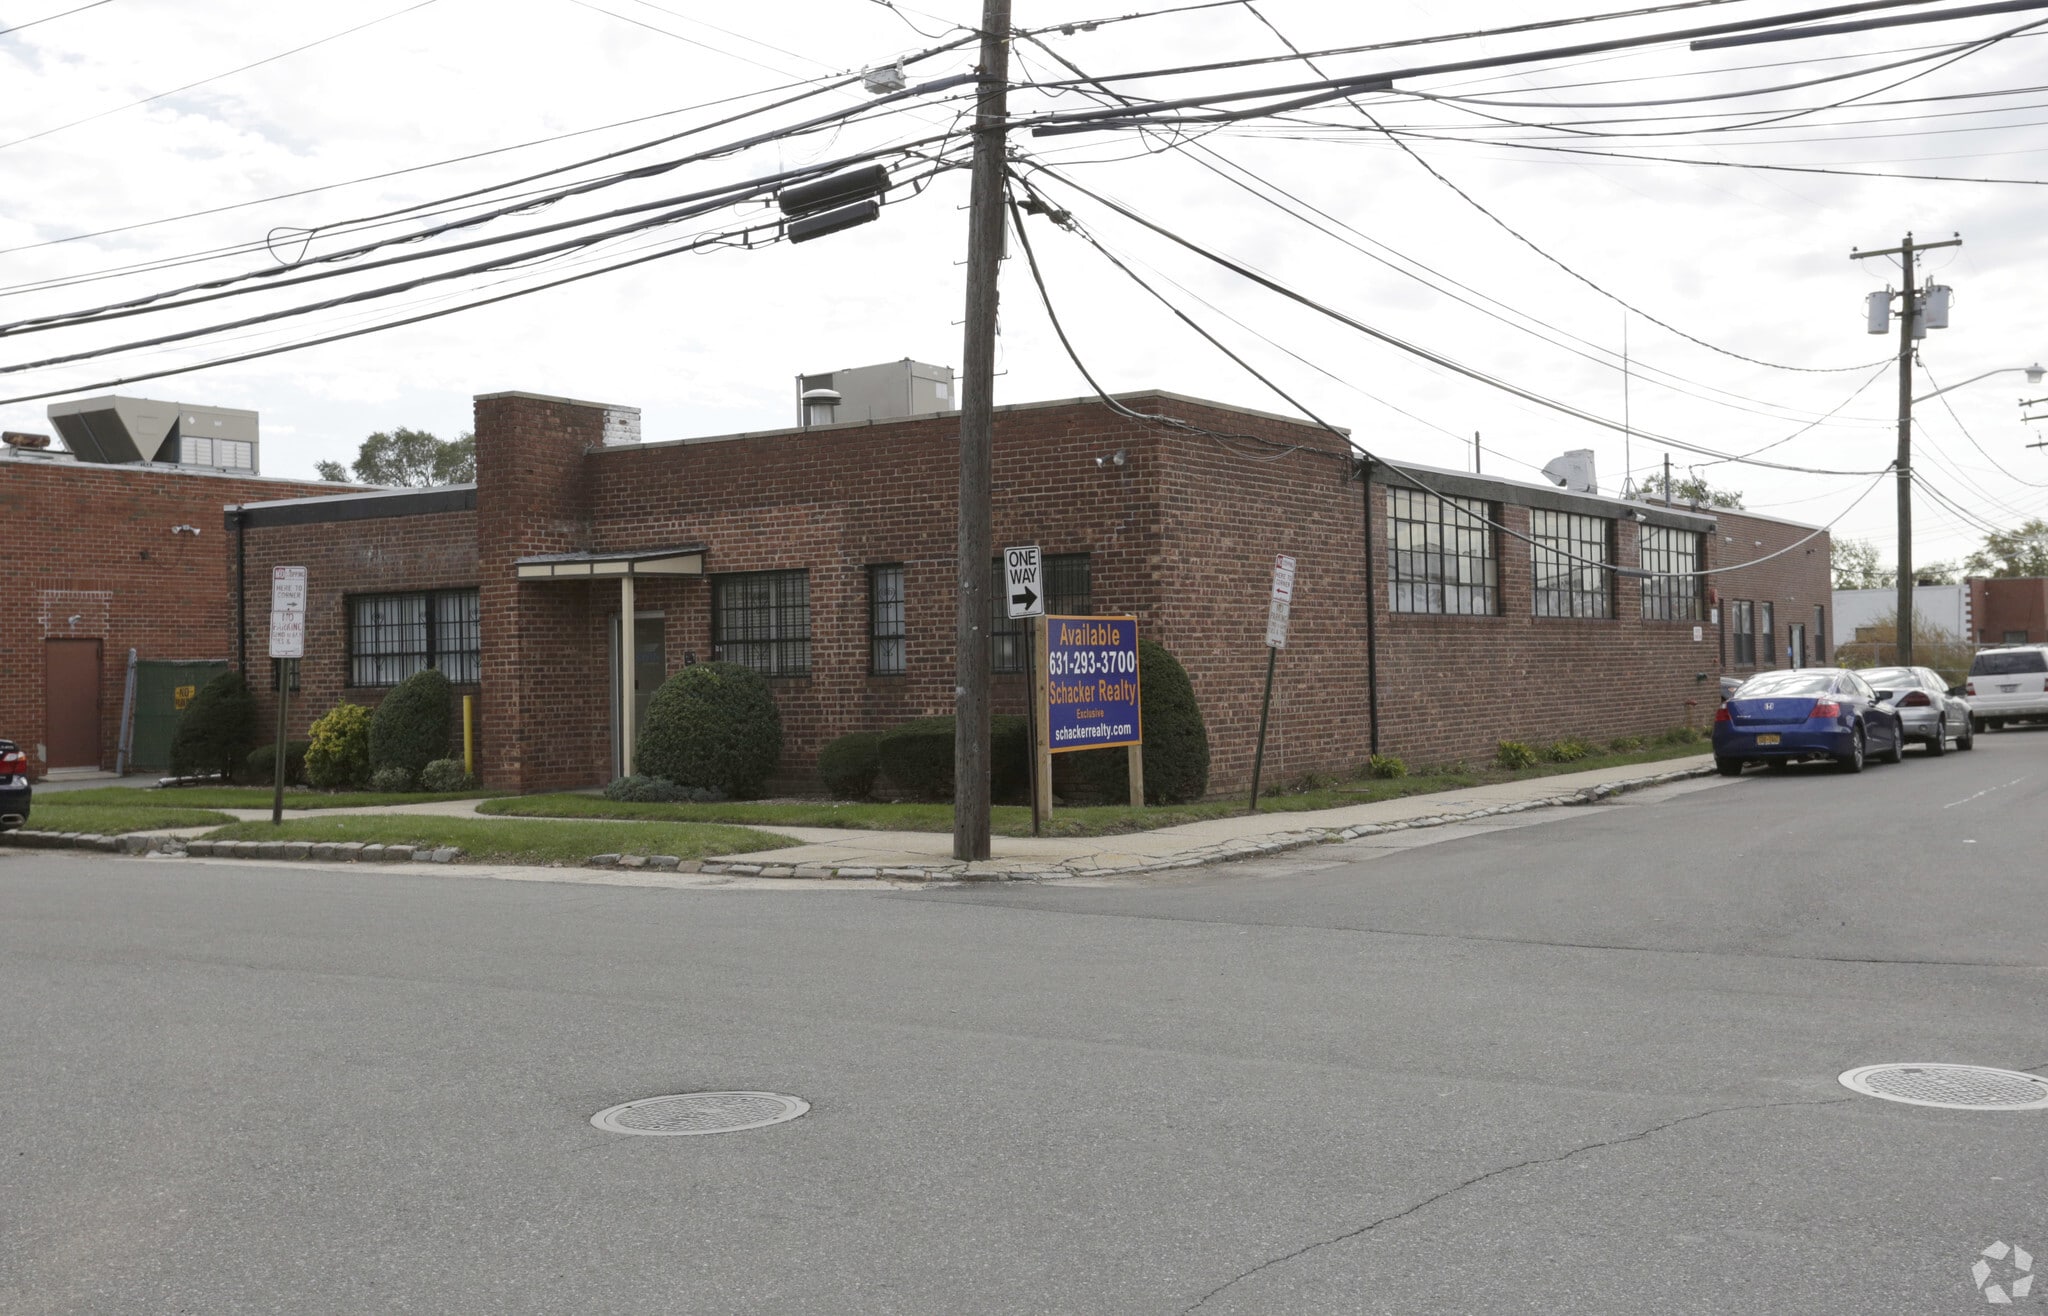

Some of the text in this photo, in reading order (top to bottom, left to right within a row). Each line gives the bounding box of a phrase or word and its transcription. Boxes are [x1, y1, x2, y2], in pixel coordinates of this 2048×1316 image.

[1009, 550, 1037, 567] ONE
[1010, 567, 1037, 585] WAY
[276, 584, 303, 592] HERE TO
[277, 591, 301, 599] CORNER
[1060, 623, 1120, 646] Available
[1049, 650, 1135, 675] 631-293-3700
[1049, 678, 1136, 706] Schacker Realty
[1076, 708, 1105, 719] Exclusive
[1055, 722, 1132, 741] schackerrealty.com
